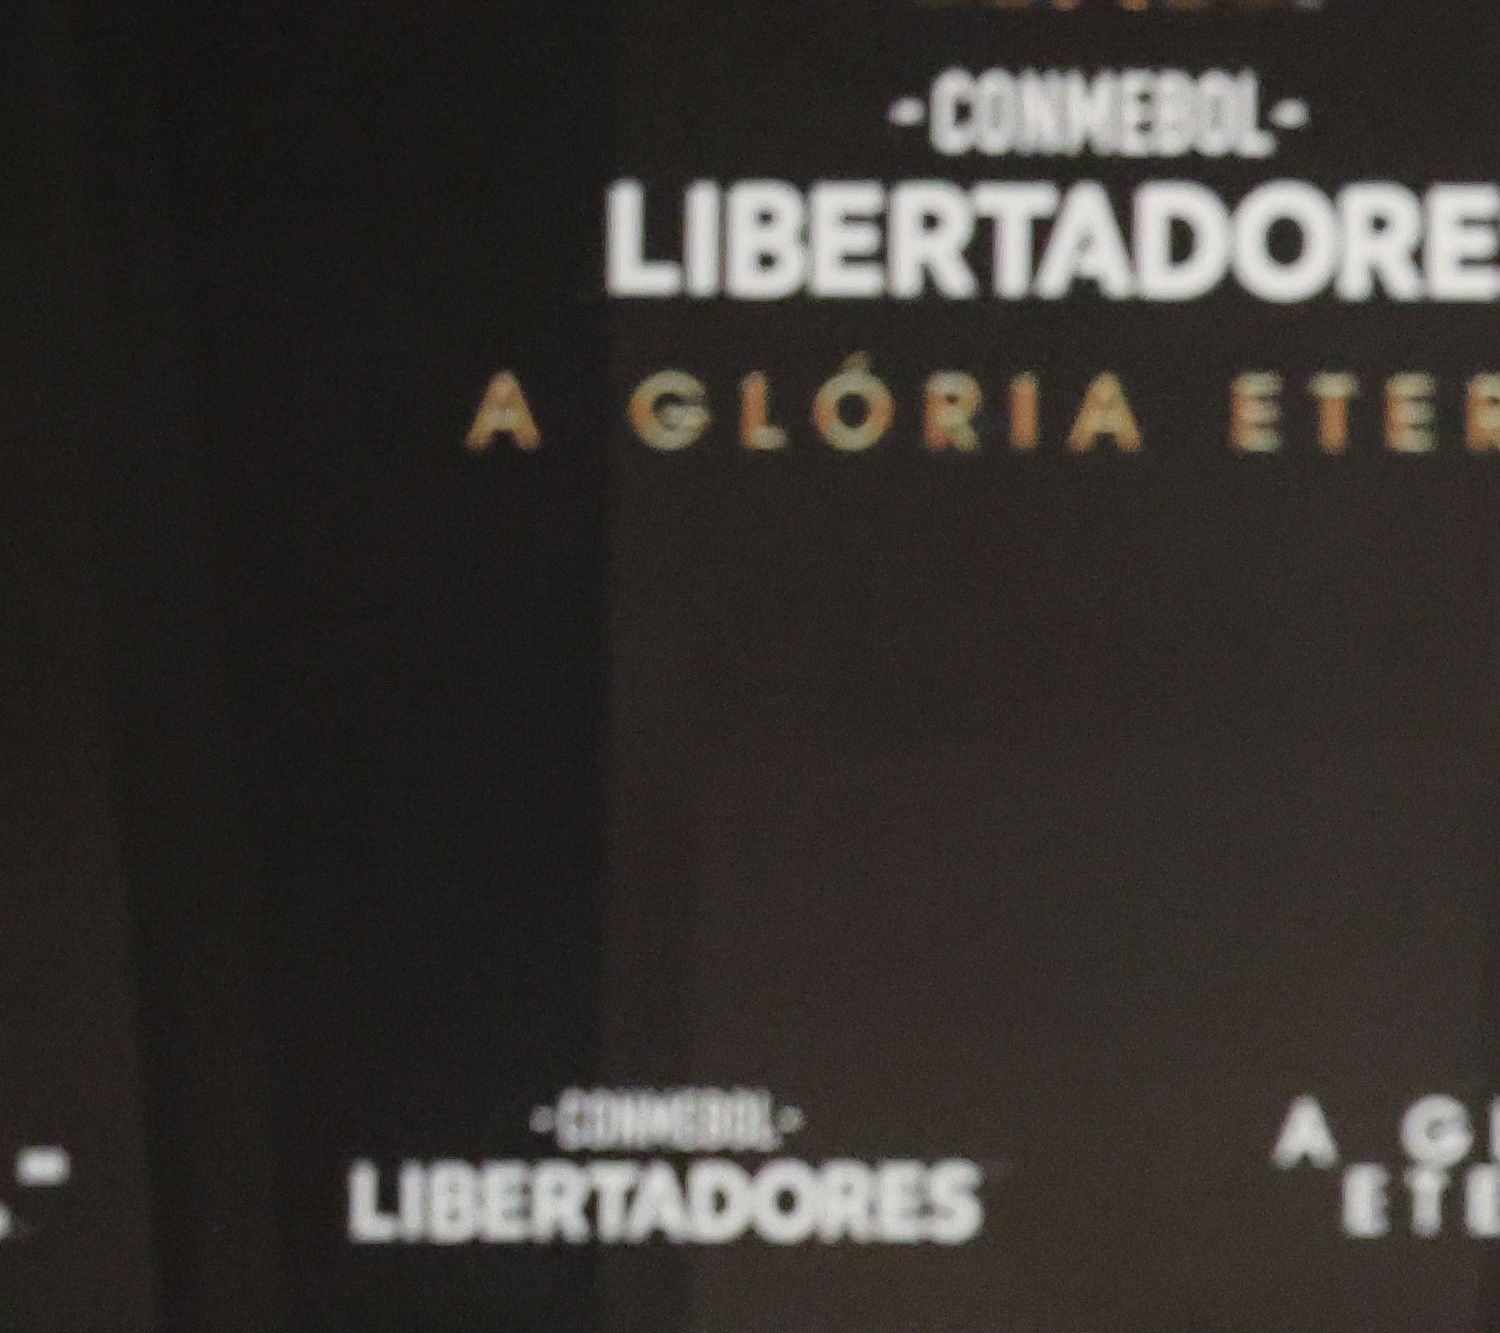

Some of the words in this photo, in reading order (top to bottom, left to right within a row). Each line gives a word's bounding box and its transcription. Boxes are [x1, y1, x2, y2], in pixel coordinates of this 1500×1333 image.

[467, 371, 540, 448] A
[629, 354, 1141, 452] GLÓRIA
[1274, 1097, 1337, 1166] A
[350, 1159, 983, 1244] LIBERTADORES
